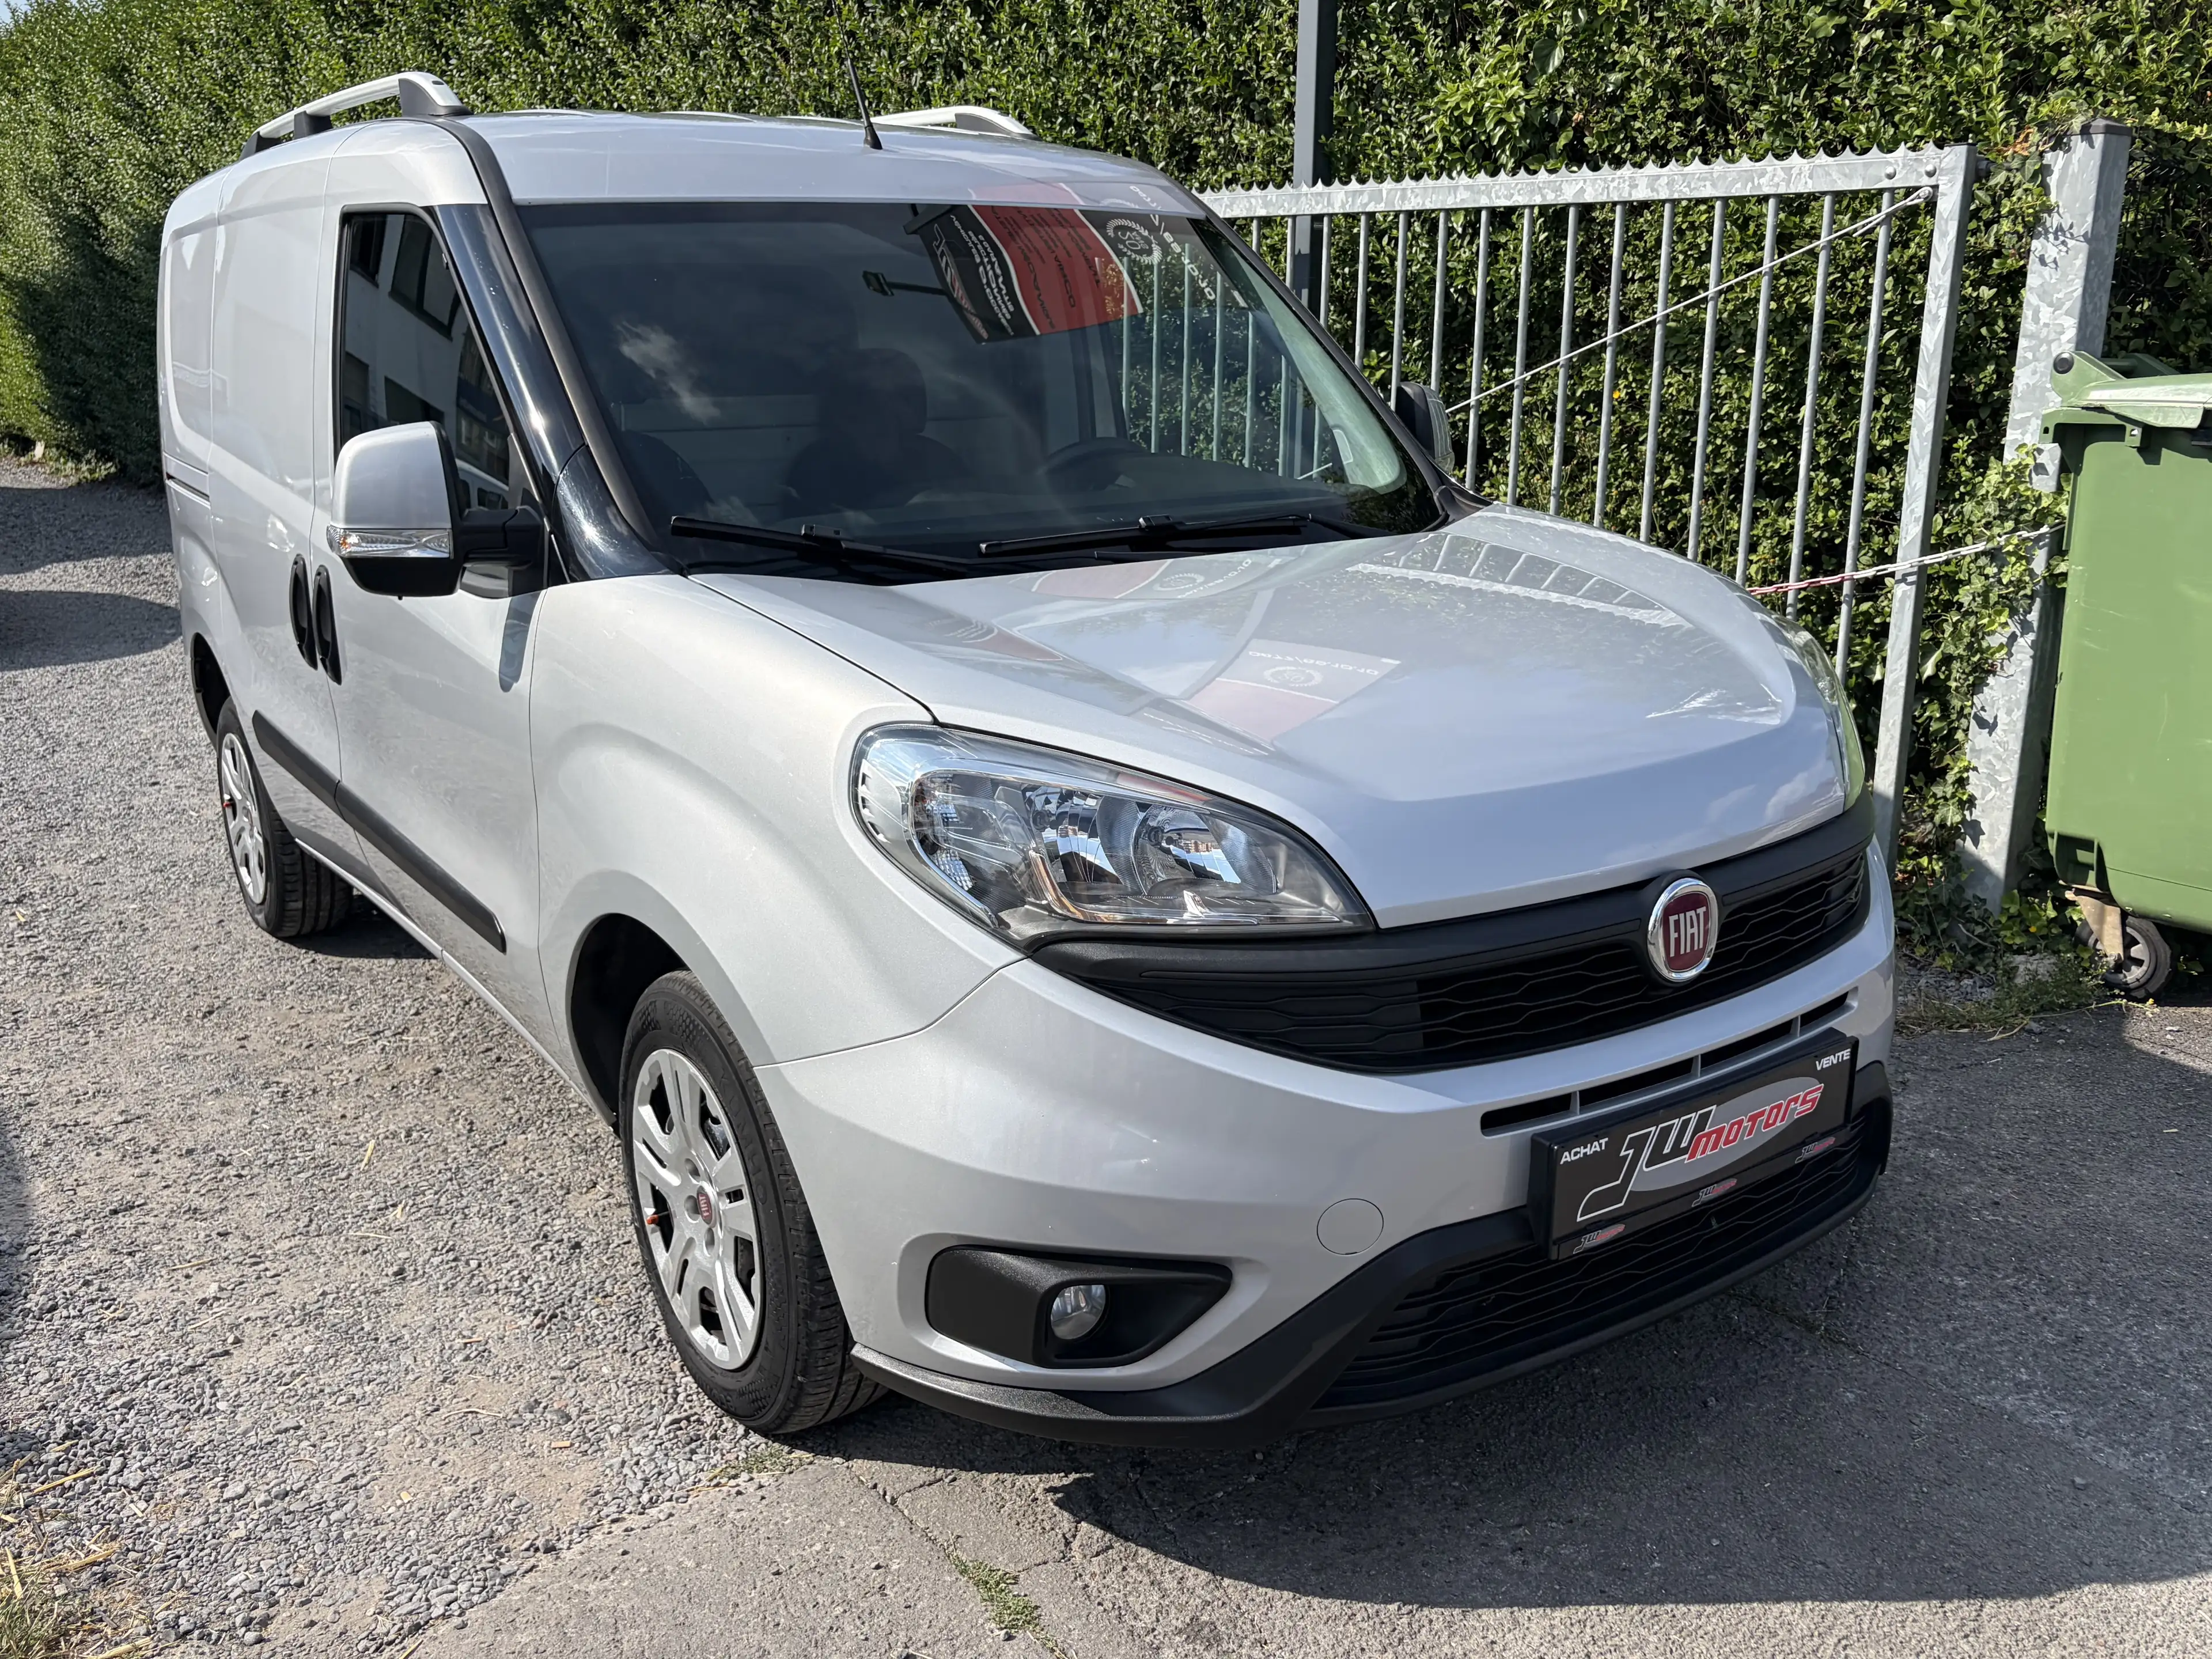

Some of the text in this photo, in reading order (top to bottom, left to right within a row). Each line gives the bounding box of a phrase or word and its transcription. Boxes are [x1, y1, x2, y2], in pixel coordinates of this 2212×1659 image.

[1669, 906, 1707, 957] FIAT
[1815, 1049, 1851, 1070] VENTE
[1560, 1137, 1609, 1164] ACHAT
